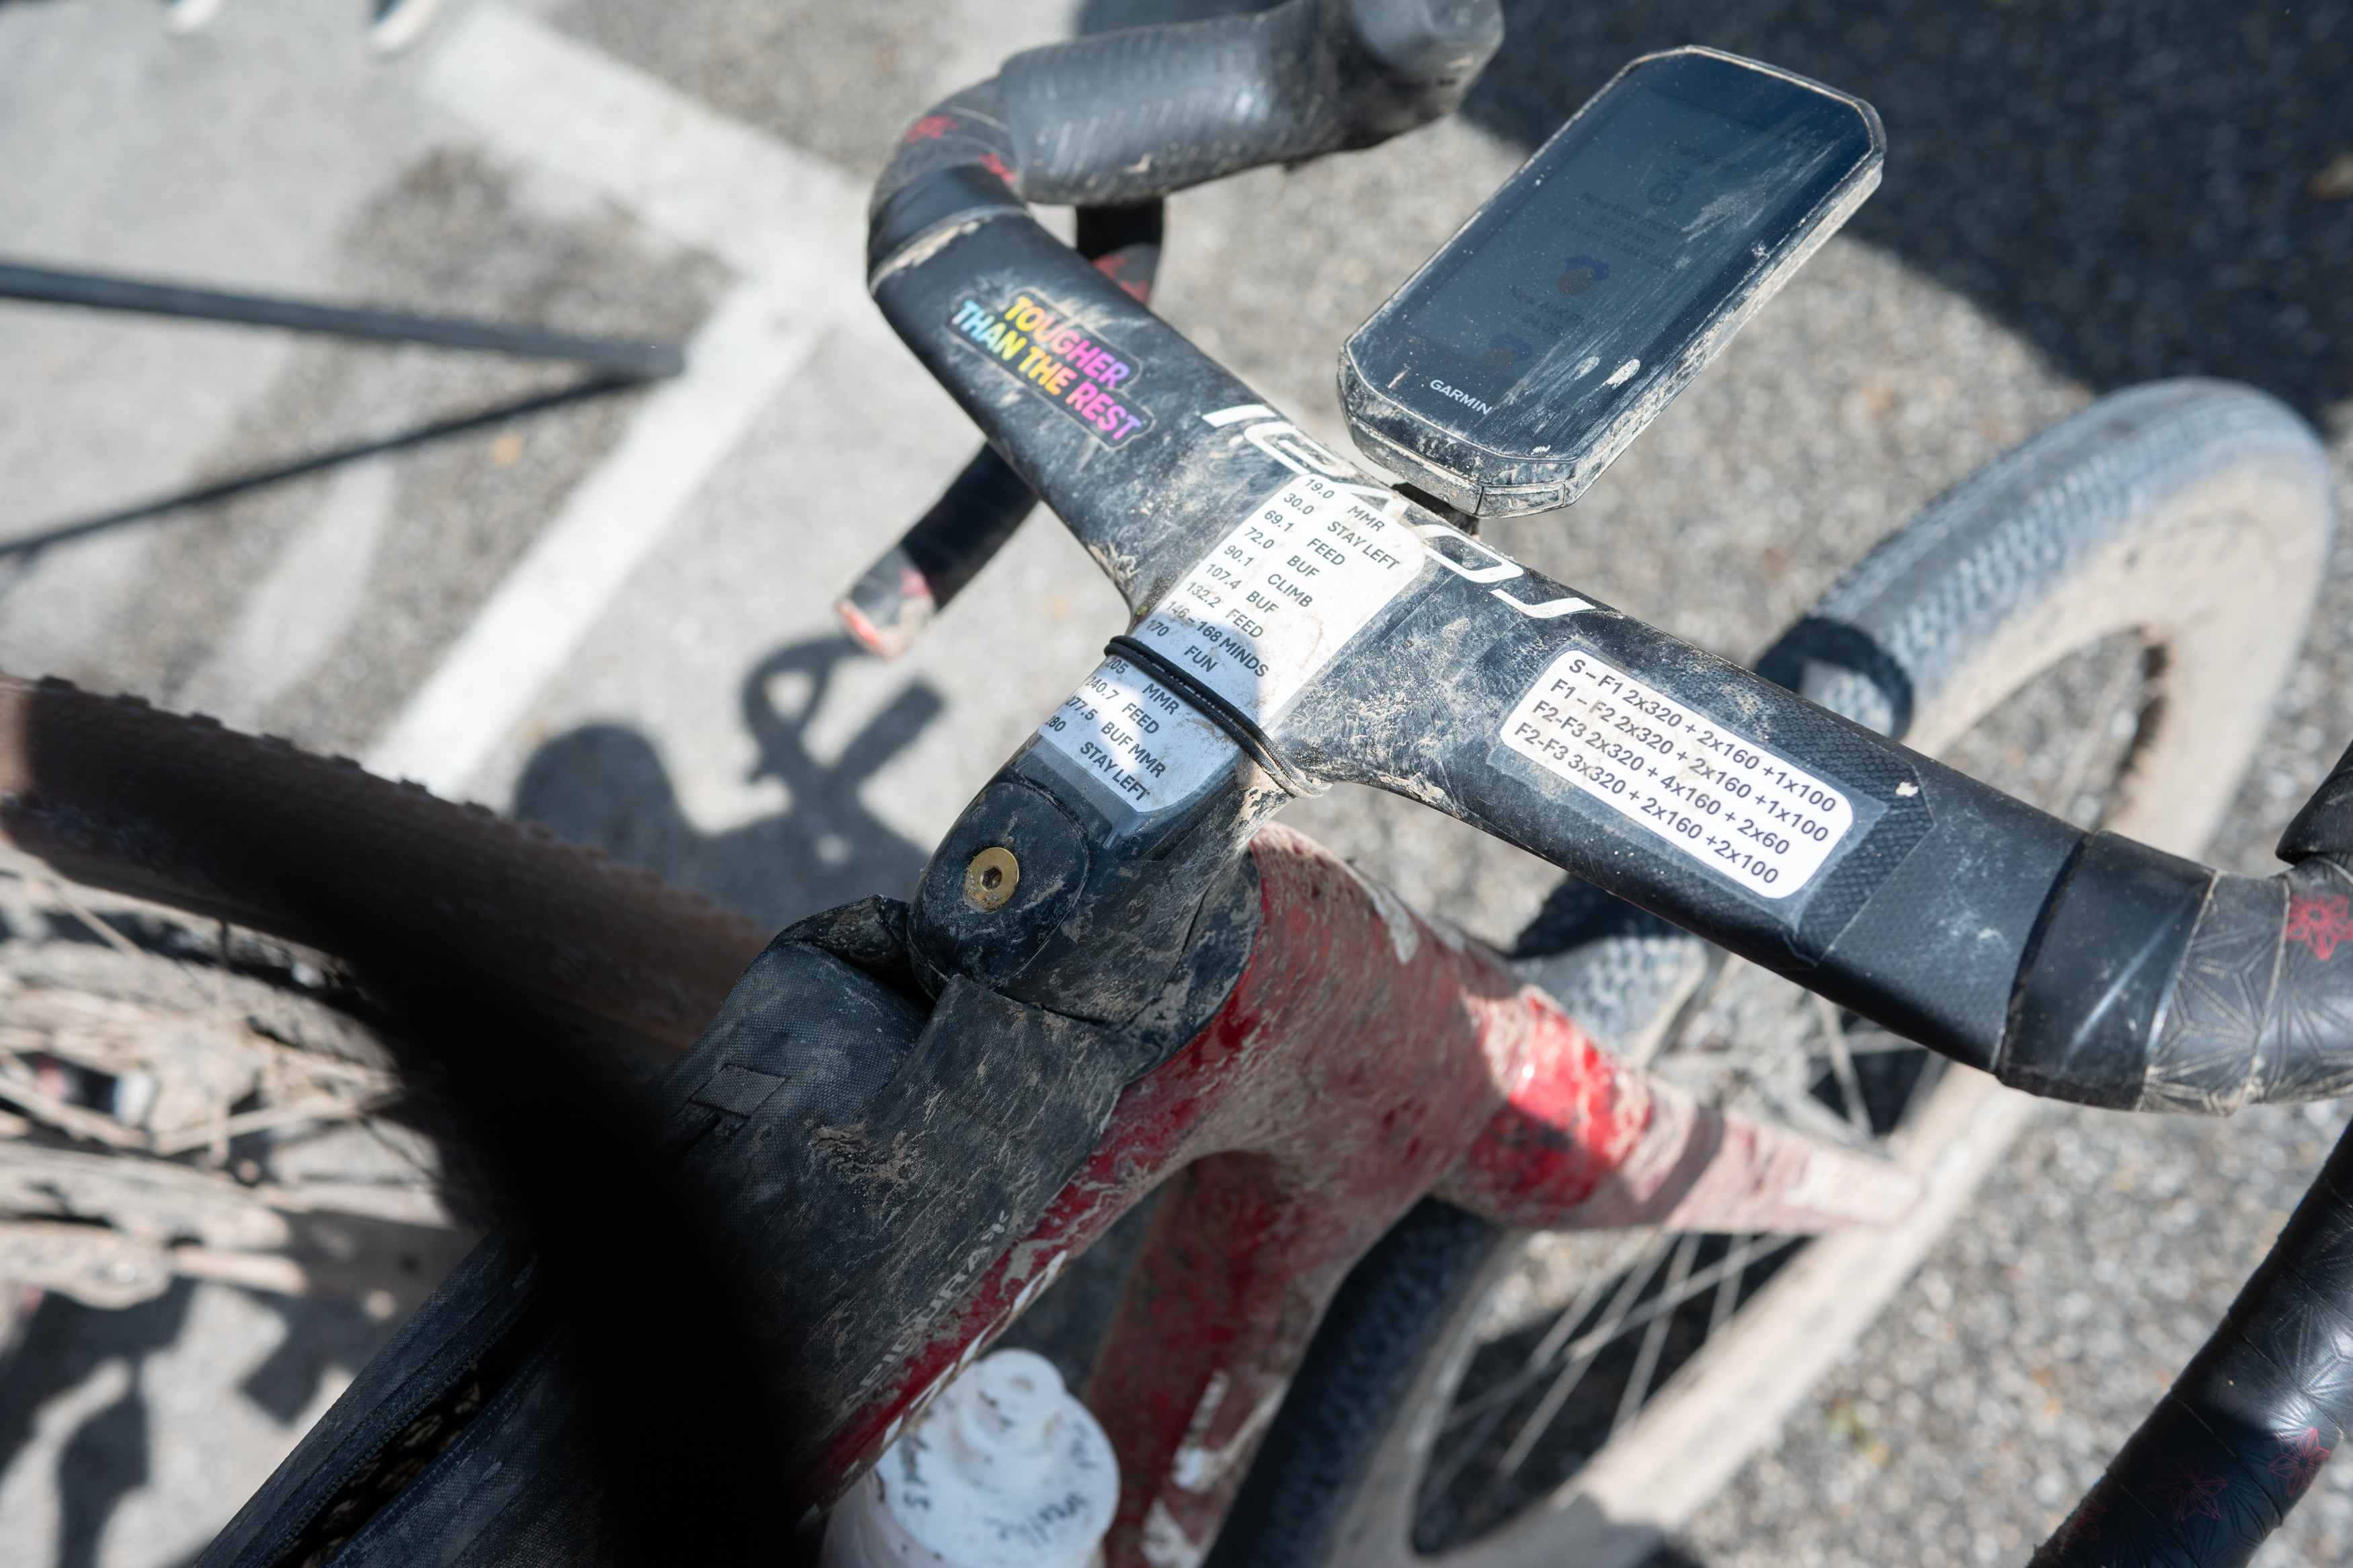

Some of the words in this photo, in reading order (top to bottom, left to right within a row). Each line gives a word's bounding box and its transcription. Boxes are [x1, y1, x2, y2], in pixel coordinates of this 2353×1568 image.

[952, 300, 1027, 361] THAN
[1018, 345, 1077, 395] THE
[1065, 380, 1142, 440] REST
[1004, 295, 1130, 388] TOUGHER
[1430, 379, 1492, 415] GARMIN
[1284, 493, 1314, 515] 30.0
[1327, 522, 1367, 547] STAY
[1362, 544, 1400, 569] LEFT
[1306, 479, 1334, 499] 19.0
[1347, 505, 1386, 532] MMR
[1244, 527, 1275, 548] 72.0
[1287, 555, 1320, 578] BUF
[1265, 510, 1294, 532] 69.1
[1306, 538, 1345, 565] FEED
[1206, 563, 1242, 589] 107.4
[1246, 591, 1279, 614] BUF
[1224, 546, 1254, 567] 90.1
[1267, 574, 1313, 607] CLIMB
[1166, 601, 1190, 618] 146
[1197, 620, 1223, 643] 168
[1218, 637, 1269, 677] MINDS
[1187, 582, 1222, 608] 132.2
[1225, 608, 1264, 638] FEED
[1146, 619, 1169, 636] 170
[1183, 645, 1218, 673] FUN
[1084, 676, 1120, 700] 240.7
[1121, 702, 1160, 734] FEED
[1105, 657, 1129, 675] 205
[1142, 683, 1180, 715] MMR
[1065, 695, 1099, 720] 277.5
[1100, 721, 1133, 747] BUF
[1127, 743, 1166, 778] MMR
[1550, 678, 1576, 699] F1
[1589, 700, 1616, 723] F2
[1613, 716, 1674, 755] 2x320
[1688, 757, 1752, 798] 2x160
[1622, 690, 1682, 727] 2x320
[1696, 730, 1760, 770] 2x160
[1080, 741, 1119, 773] STAY
[1112, 769, 1150, 801] LEFT
[1514, 722, 1569, 761] F2-F3
[1568, 753, 1626, 794] 3x320
[1640, 797, 1702, 839] 2x160
[1532, 700, 1587, 738] F2-F3
[1585, 731, 1644, 772] 2x320
[1660, 776, 1721, 815] 4x160
[1737, 819, 1790, 854] 2x60
